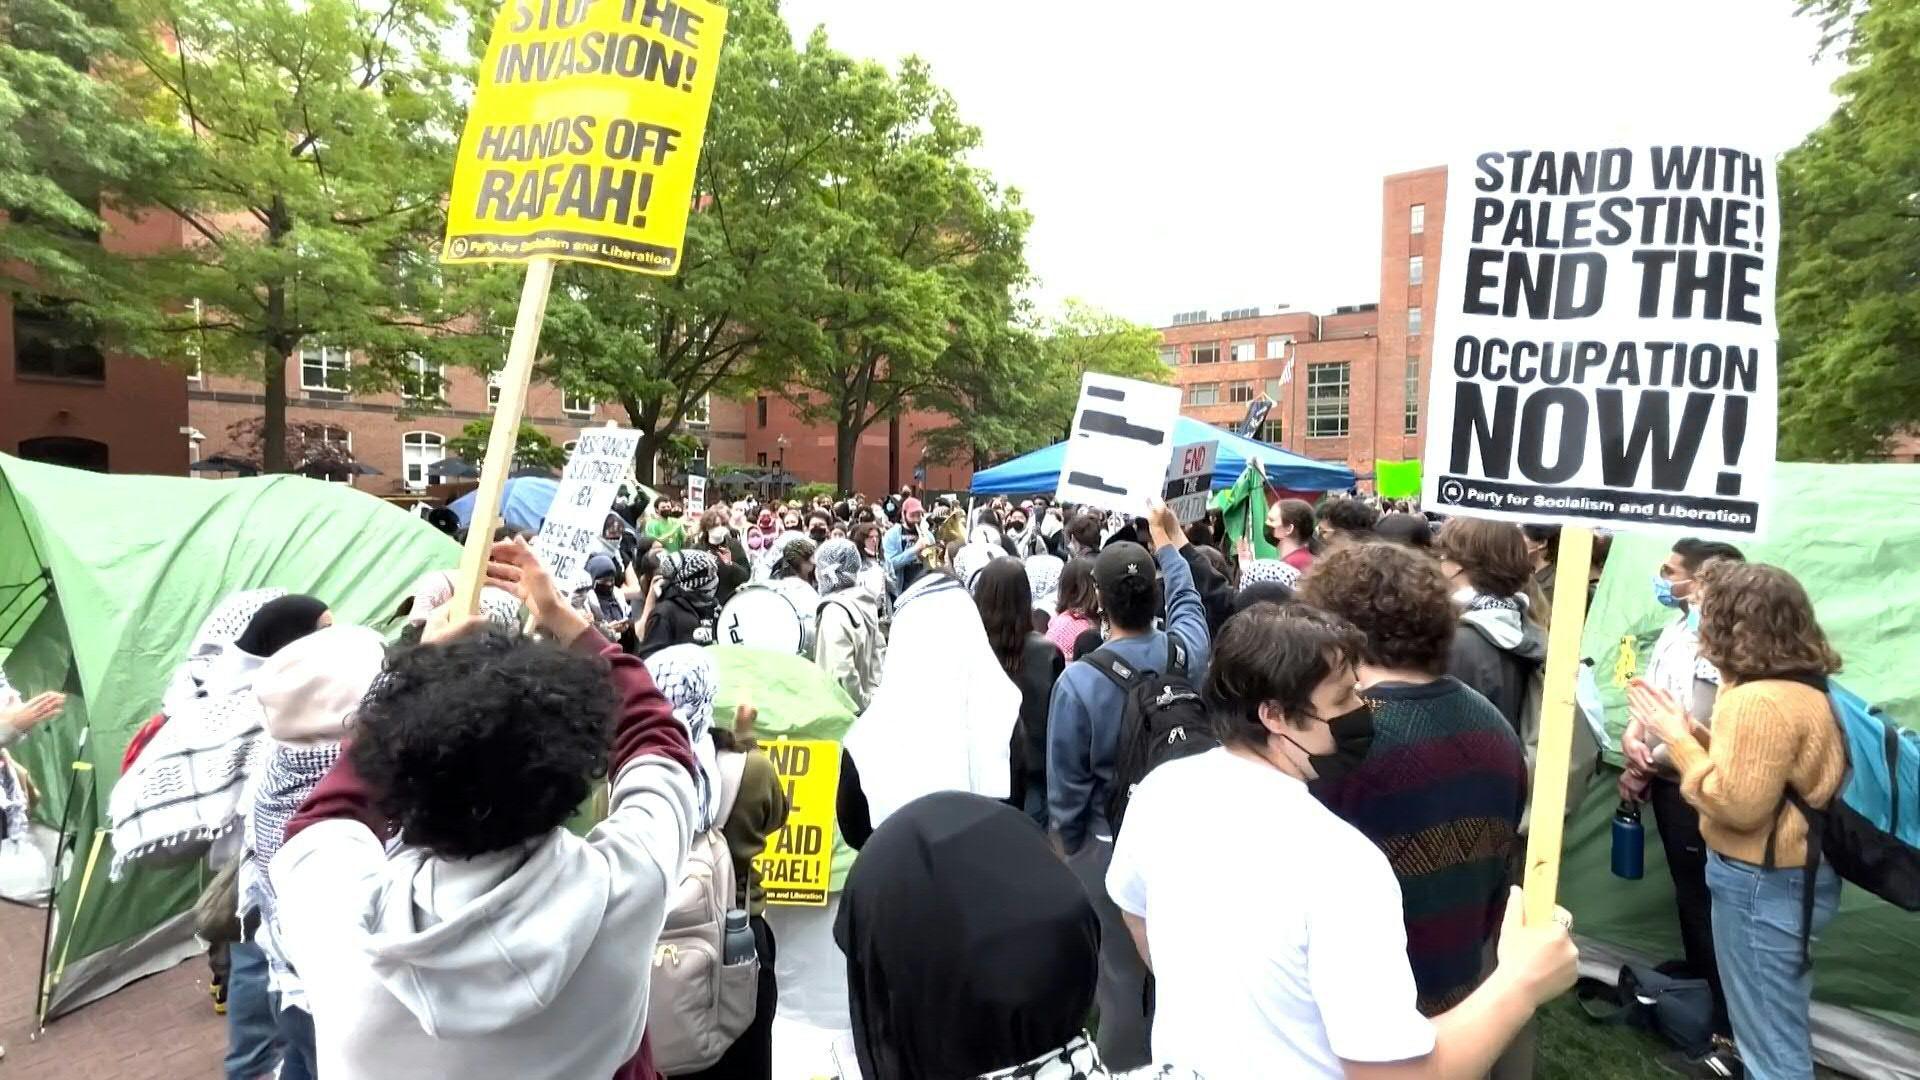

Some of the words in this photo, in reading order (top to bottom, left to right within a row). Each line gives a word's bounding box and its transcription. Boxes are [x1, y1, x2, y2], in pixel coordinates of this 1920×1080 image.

[495, 32, 698, 93] INVASION!
[477, 115, 596, 162] HANDS
[604, 119, 682, 166] OFF
[475, 163, 654, 229] RAFAH!
[1475, 147, 1633, 196] STAND
[1650, 145, 1764, 200] WITH
[1471, 196, 1764, 252] PALESTINE!
[572, 241, 599, 252] and
[601, 243, 671, 266] Liberation
[1462, 247, 1608, 320] END
[1632, 249, 1764, 325] THE
[1453, 334, 1759, 393] OCCUPATION
[1183, 445, 1206, 475] END
[1449, 381, 1749, 496] NOW!
[1467, 488, 1503, 506] Party
[1506, 493, 1530, 506] for
[1533, 494, 1614, 512] Socialism
[1619, 503, 1654, 516] and
[1658, 503, 1751, 524] Liberation
[759, 745, 811, 776] ND
[775, 825, 823, 856] AID
[776, 891, 790, 899] and
[790, 892, 823, 900] Liberation
